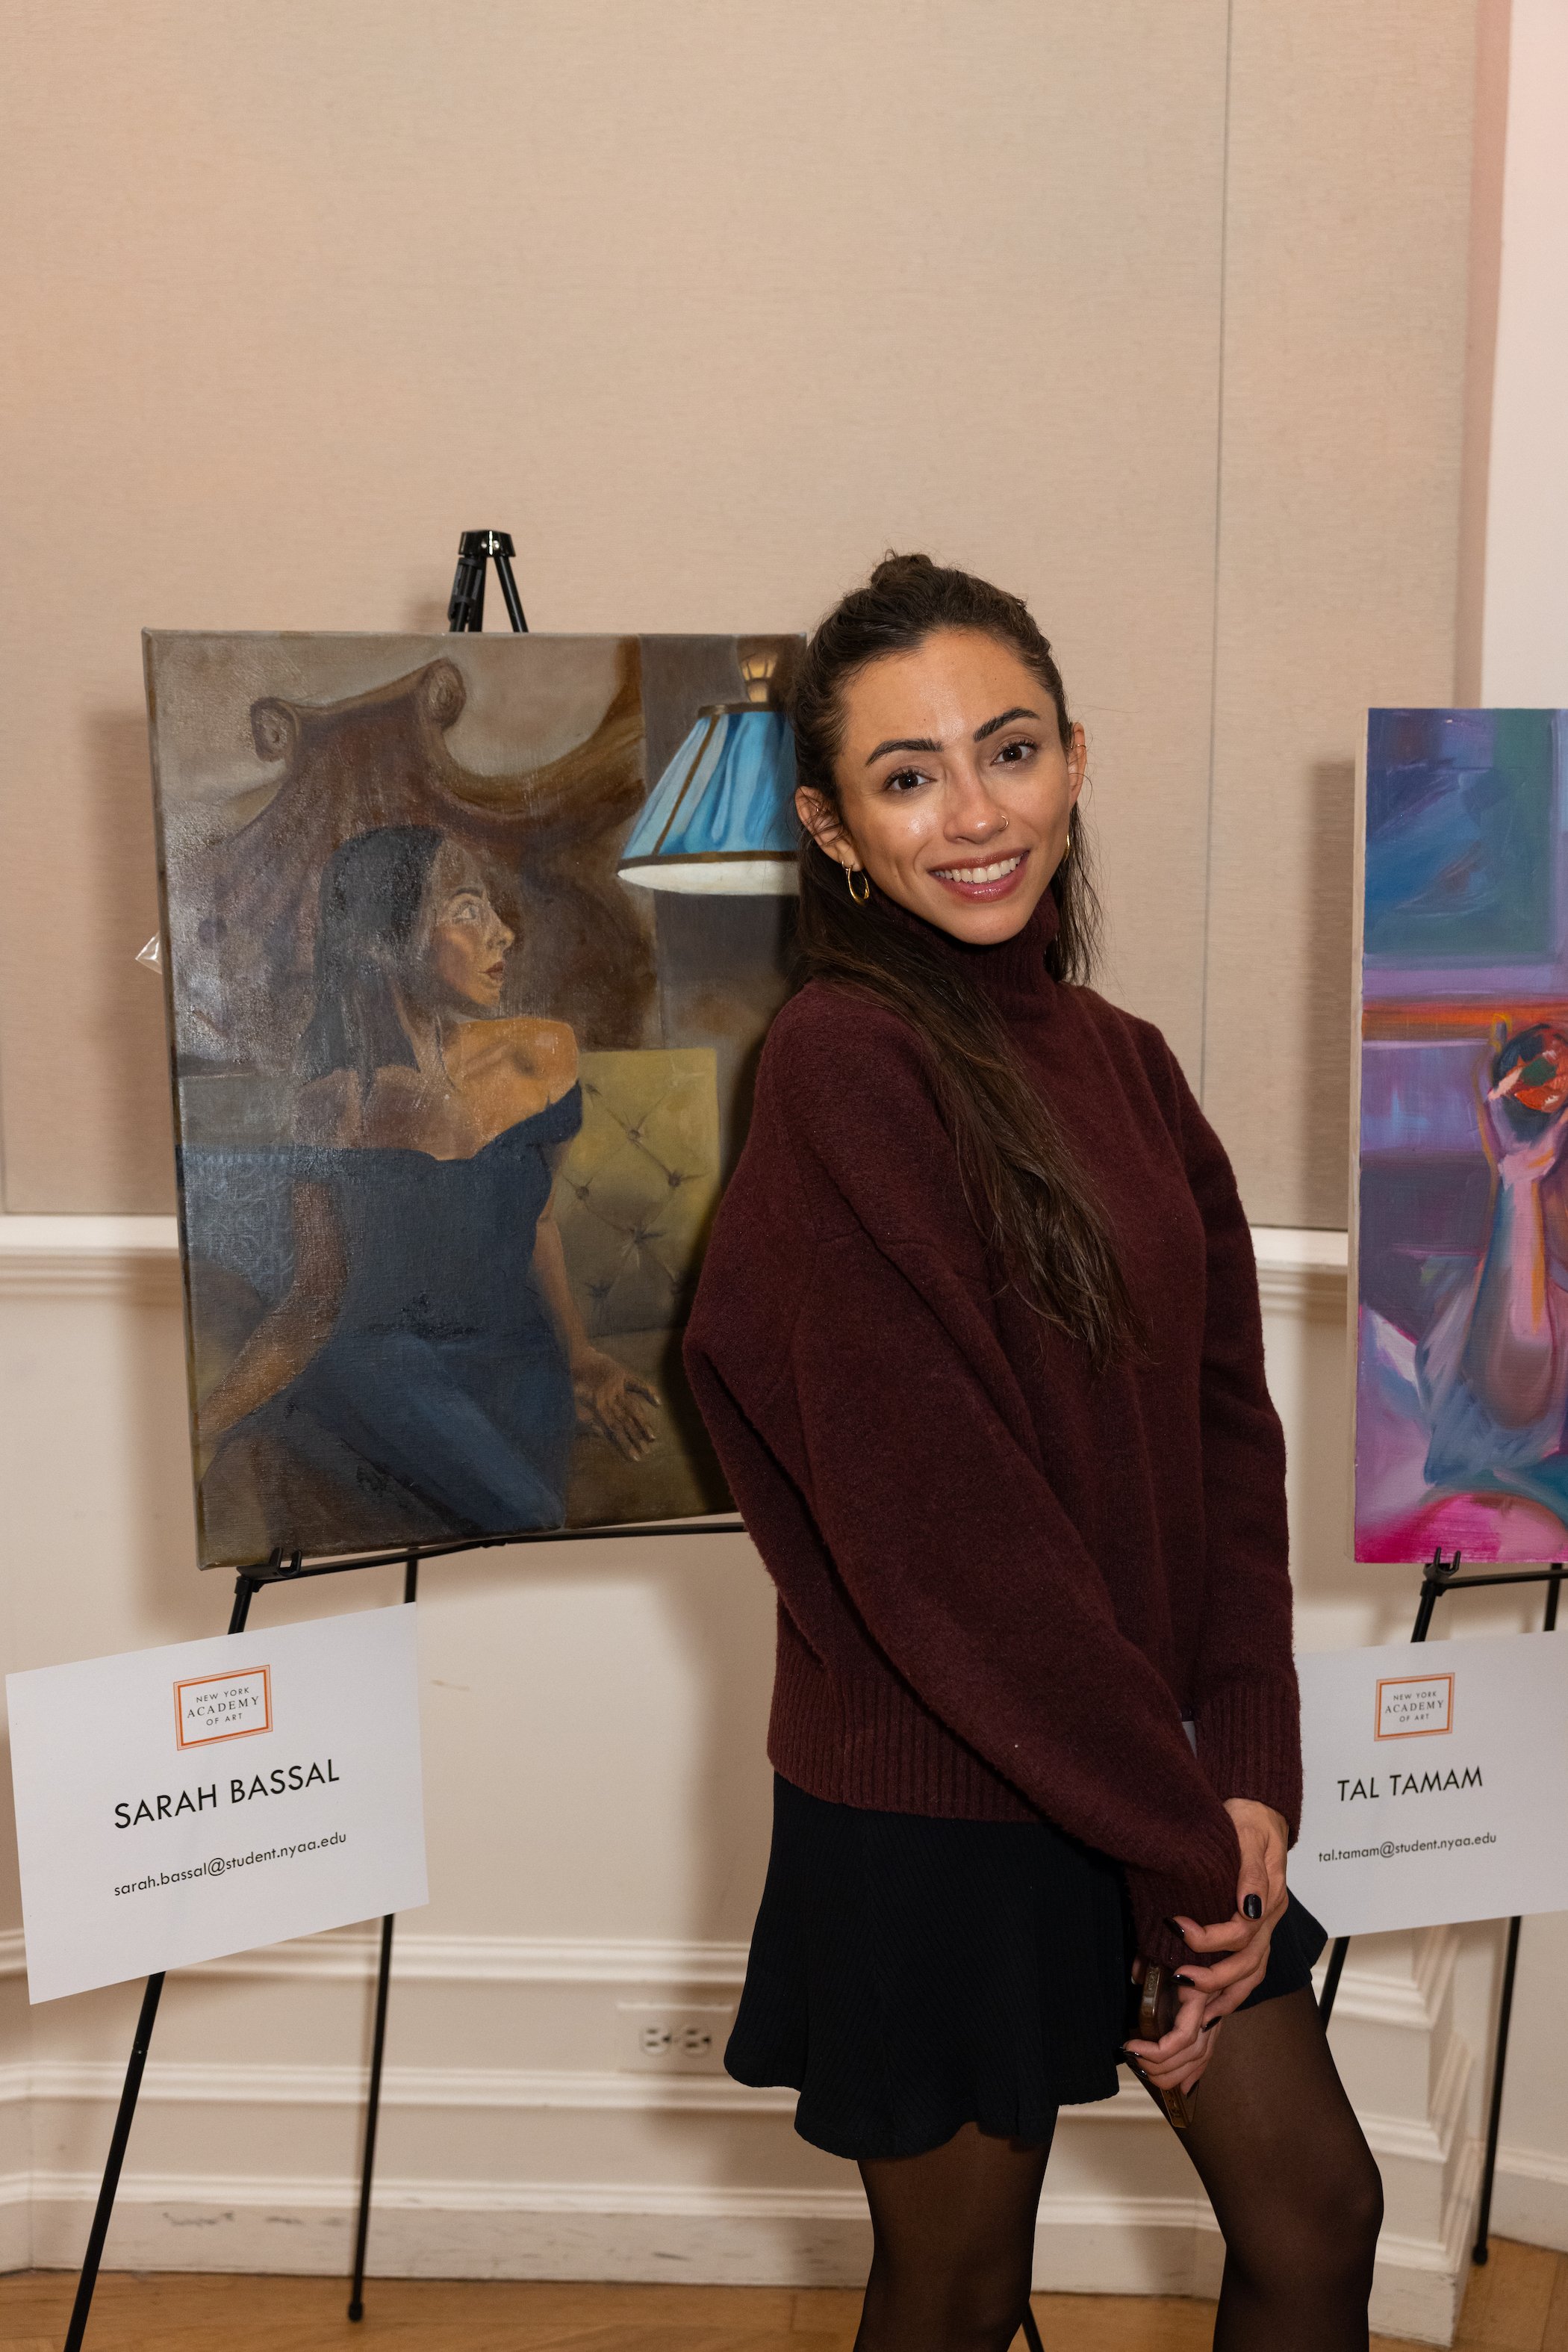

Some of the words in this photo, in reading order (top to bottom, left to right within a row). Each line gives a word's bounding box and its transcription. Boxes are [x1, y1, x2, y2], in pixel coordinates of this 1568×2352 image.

[196, 1692, 219, 1704] NEW
[223, 1687, 250, 1698] YORK
[1393, 1692, 1413, 1701] NEW
[1416, 1690, 1437, 1699] YORK
[187, 1695, 259, 1719] ACADEMY
[1384, 1699, 1444, 1714] ACADEMY
[205, 1717, 220, 1726] OF
[224, 1713, 243, 1722] ART
[1399, 1714, 1410, 1722] OF
[1414, 1713, 1430, 1721] ART
[114, 1784, 217, 1829] SARAH
[230, 1758, 340, 1804] BASSAL
[1337, 1776, 1380, 1802] TAL
[1389, 1766, 1484, 1796] TAMAM
[1318, 1831, 1497, 1863] tal.tamam@student.nyaa.edu
[114, 1831, 346, 1896] sarah.bassal@student.nyaa.edu
